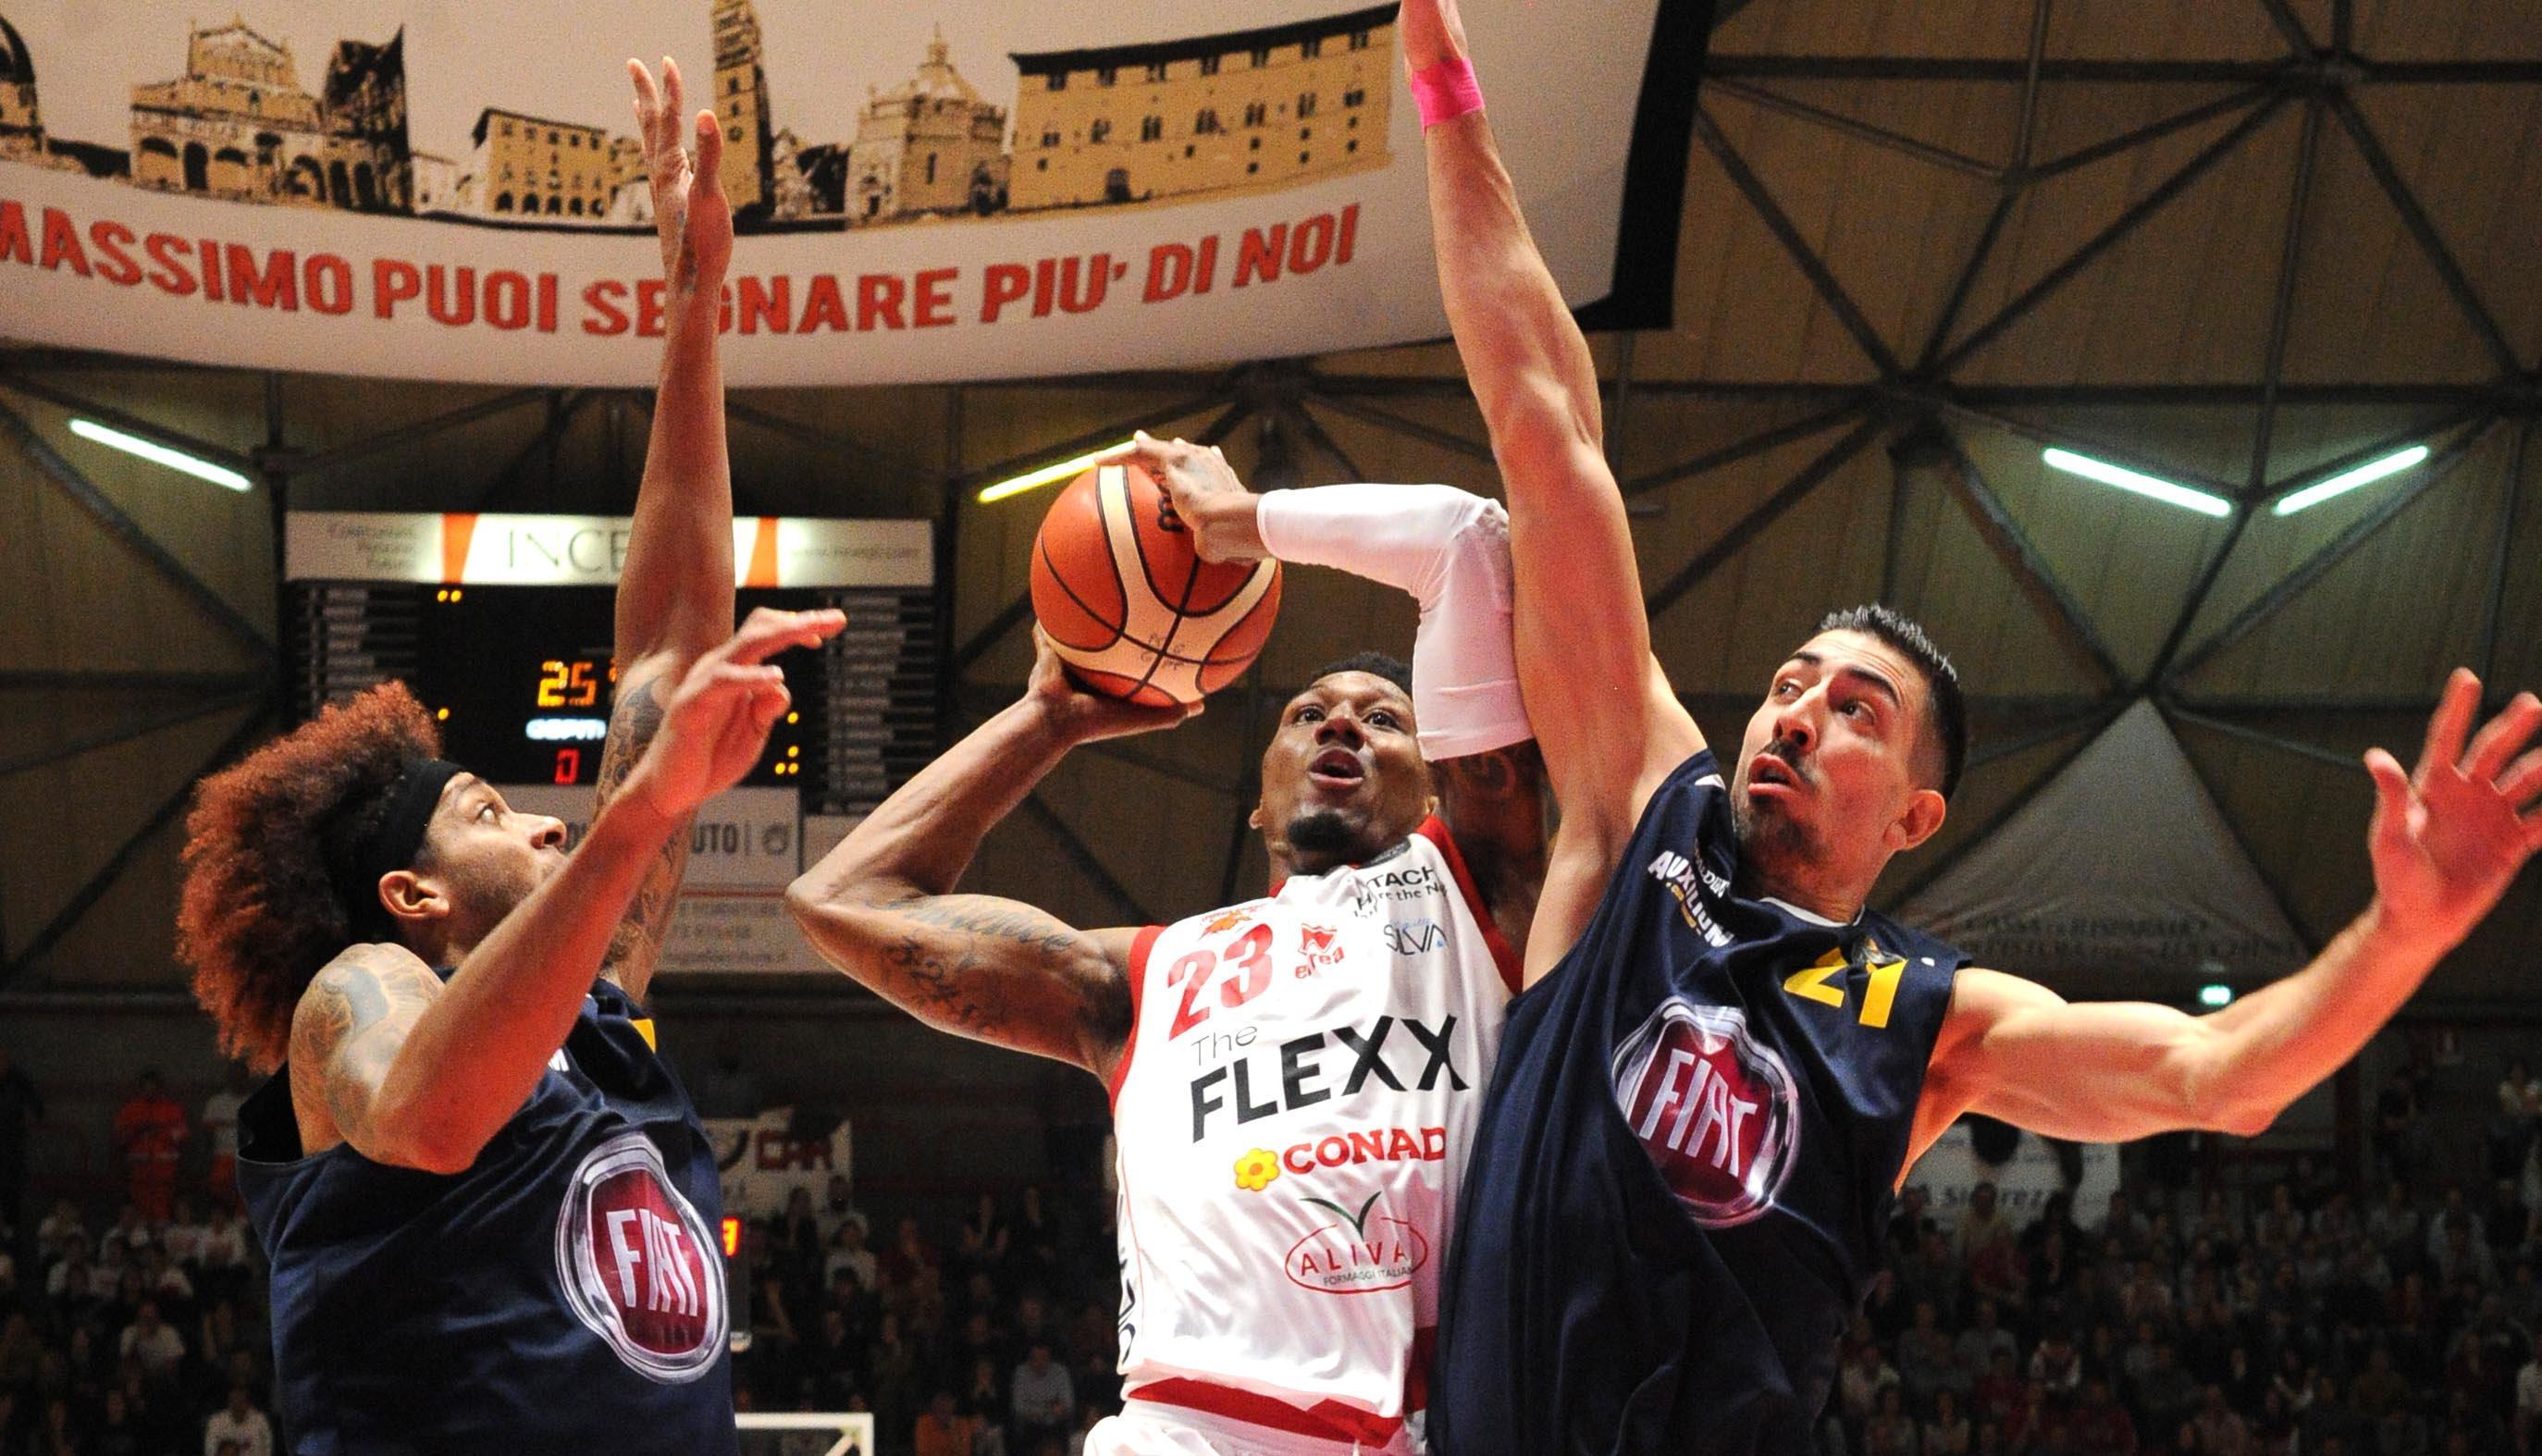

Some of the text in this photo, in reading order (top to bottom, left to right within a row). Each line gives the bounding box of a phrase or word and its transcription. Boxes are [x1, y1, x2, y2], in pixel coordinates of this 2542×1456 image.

[372, 257, 560, 334] PUOI
[580, 267, 960, 338] SENARE
[1141, 235, 1219, 304] DI
[1232, 204, 1360, 289] NOI
[1166, 923, 1274, 1042] 23
[1190, 1014, 1471, 1144] FLEXX
[1191, 1024, 1259, 1066] The
[1282, 1126, 1447, 1175] CONAD
[1639, 1047, 1759, 1178] FIAT
[605, 1208, 698, 1317] FIAT
[1301, 1240, 1408, 1277] ALIVA
